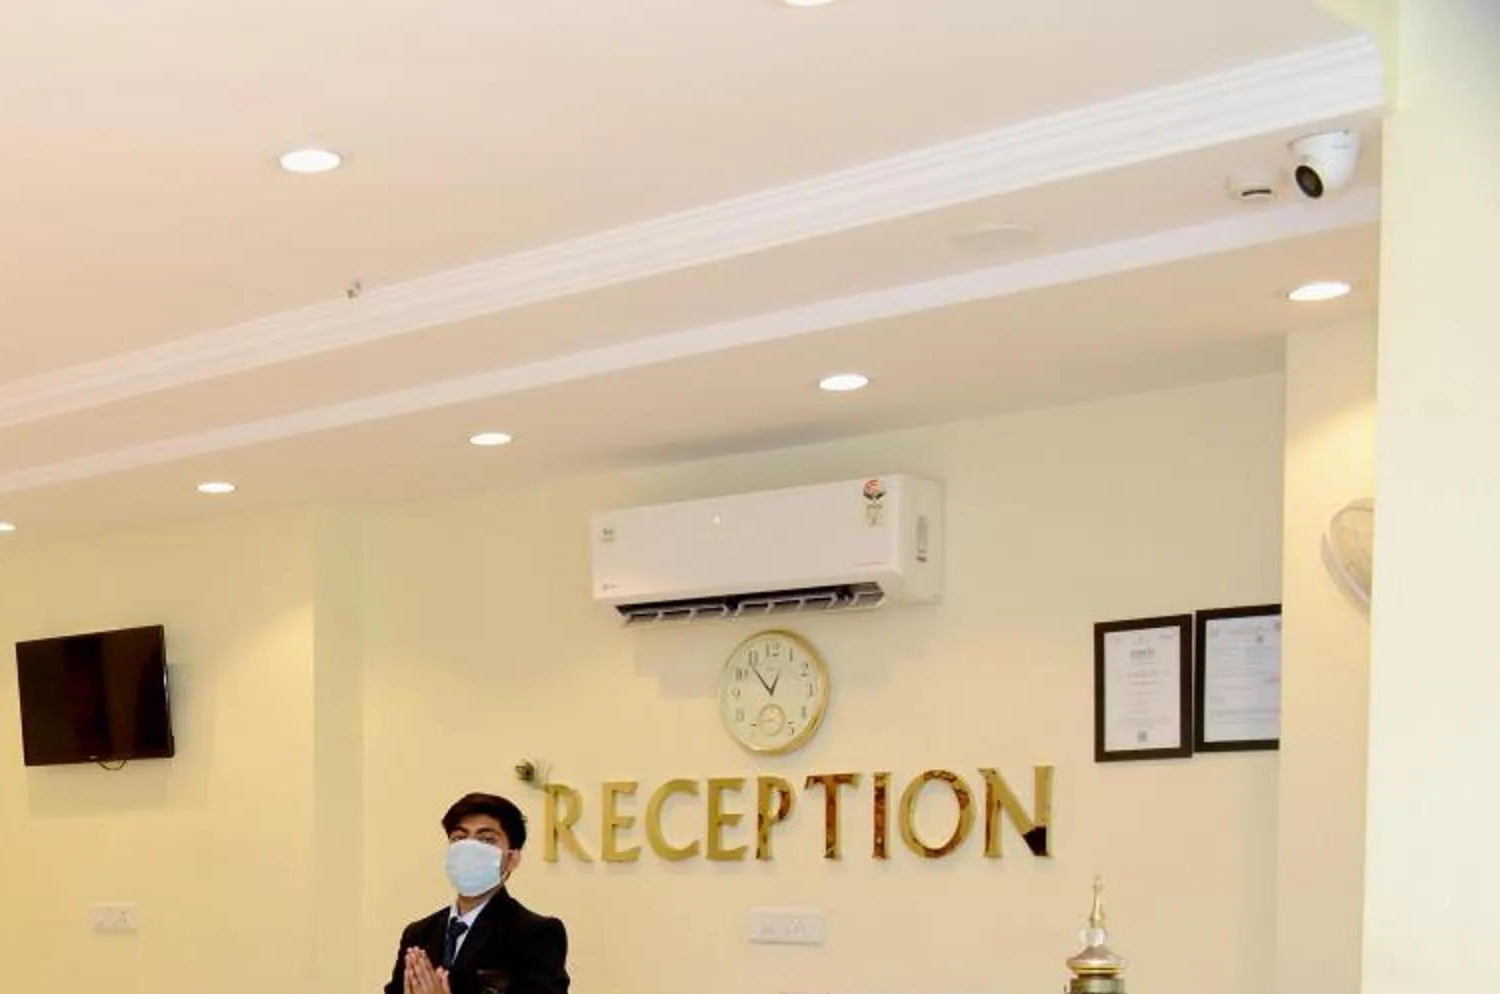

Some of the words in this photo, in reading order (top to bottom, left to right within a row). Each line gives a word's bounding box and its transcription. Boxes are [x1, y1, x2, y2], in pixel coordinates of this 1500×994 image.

[765, 641, 781, 658] 12
[799, 659, 812, 678] 2
[542, 765, 1055, 863] RECEPTION
